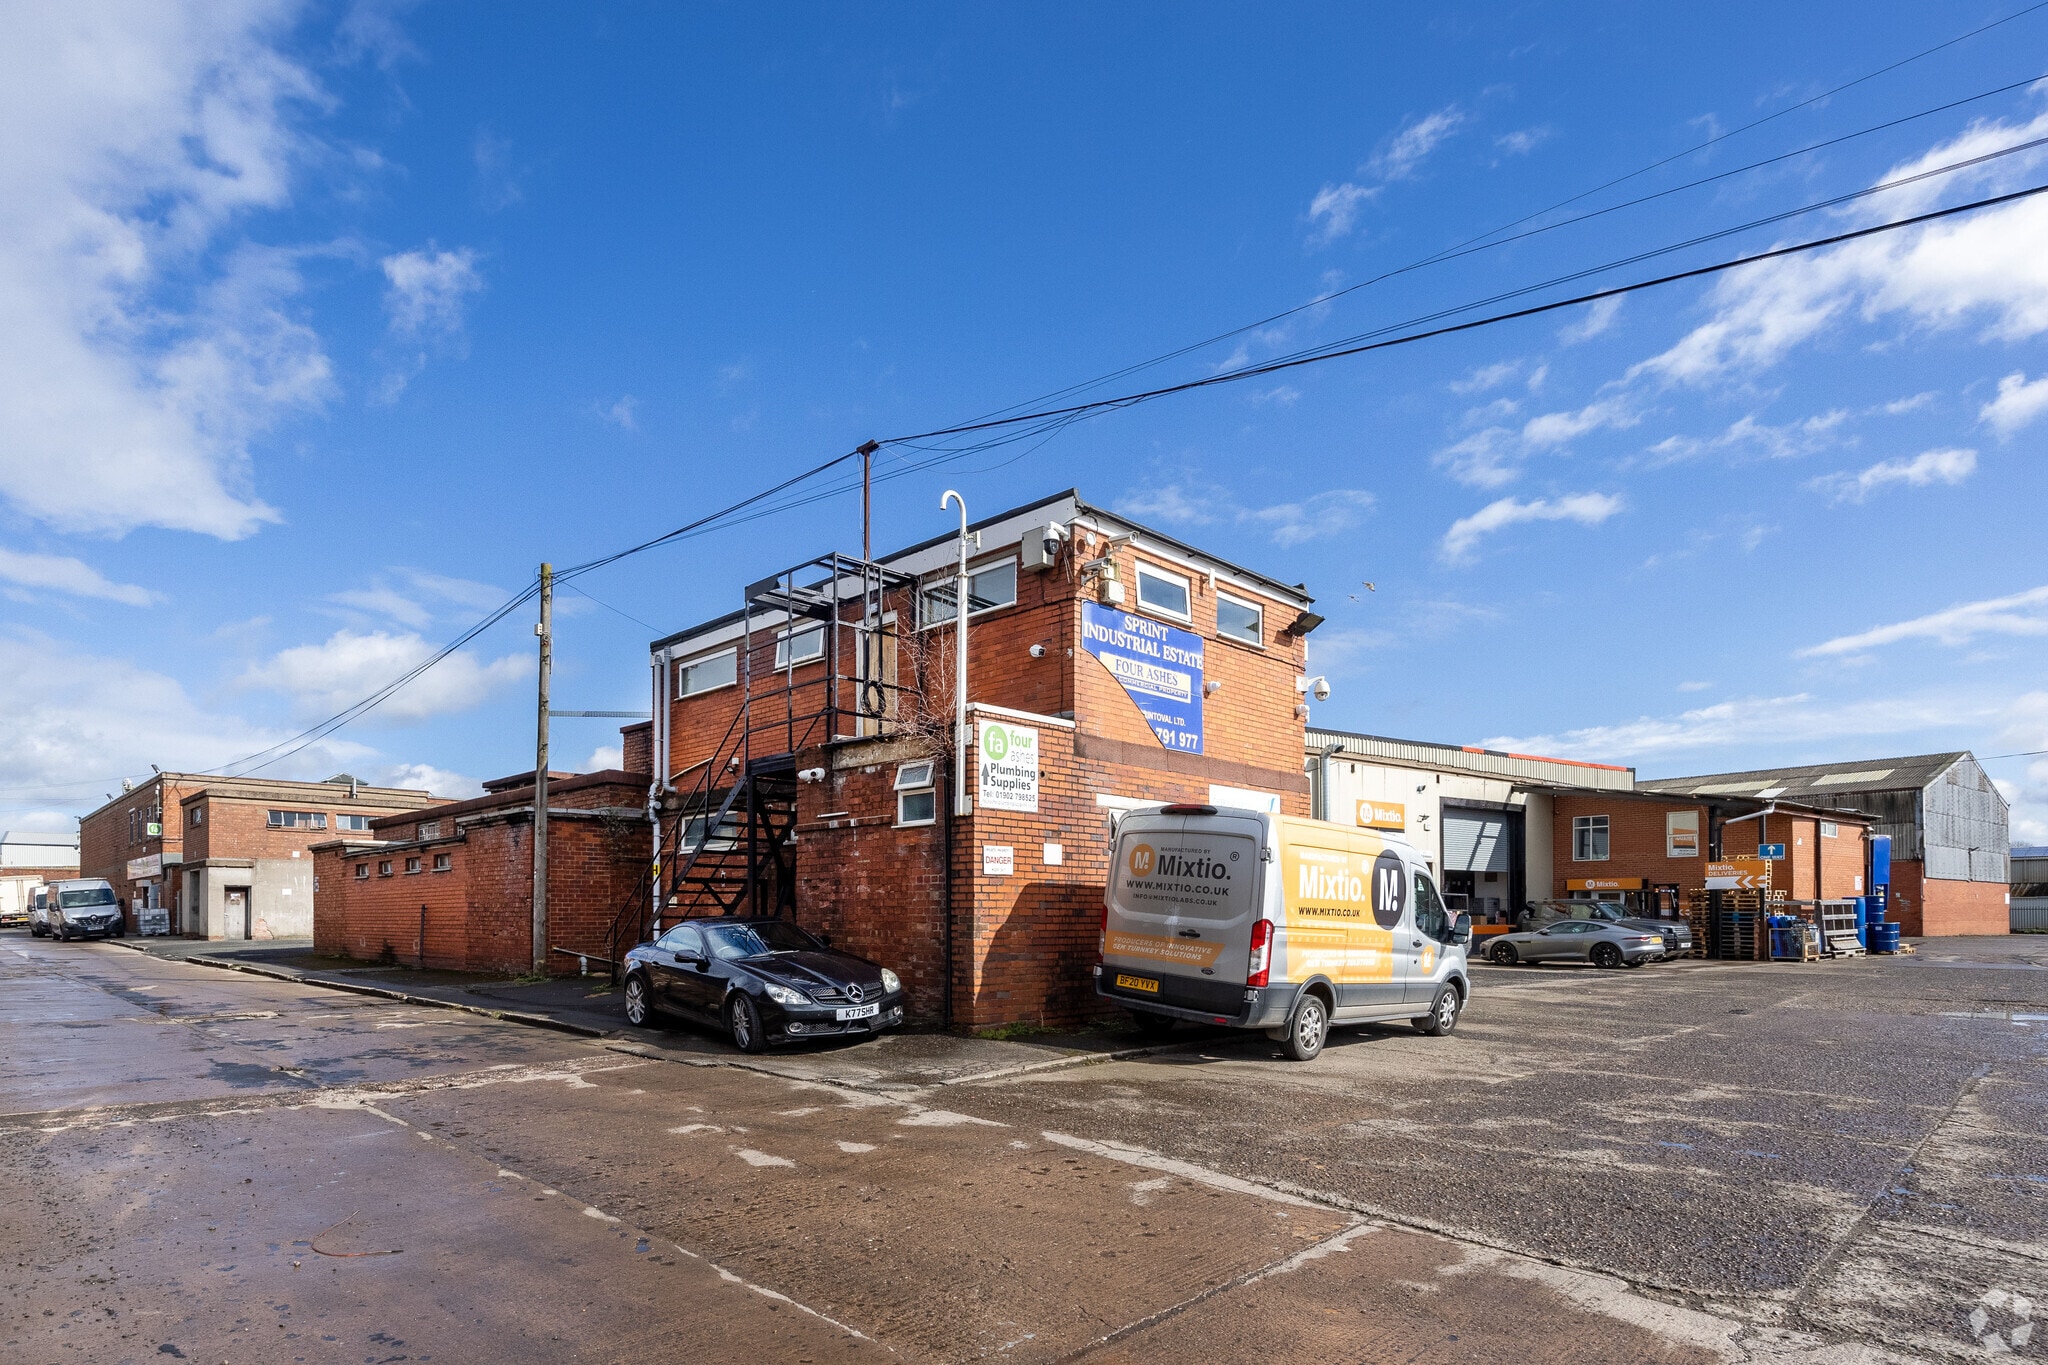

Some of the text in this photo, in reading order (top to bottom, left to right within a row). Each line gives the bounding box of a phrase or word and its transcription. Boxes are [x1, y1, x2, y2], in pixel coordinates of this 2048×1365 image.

[1124, 615, 1169, 642] SPRINT
[1083, 621, 1204, 670] INDUSTRIAL ESTATE
[1115, 658, 1178, 686] FOUR ASHES
[1158, 684, 1189, 698] PROPERTY
[1173, 716, 1187, 727] LTD.
[988, 731, 1004, 754] fa
[1010, 730, 1033, 749] four
[1155, 727, 1199, 750] 791 977
[990, 763, 1036, 782] Plumbing
[990, 775, 1031, 791] Supplies
[995, 790, 1014, 800] 01902
[1160, 846, 1203, 854] MANUFACTURED
[985, 855, 1012, 865] DANGER
[1157, 854, 1231, 880] Mixtio.
[1708, 869, 1748, 877] DELIVERIES
[1126, 880, 1230, 897] WWW.MIXTIO.CO.UK
[1299, 863, 1366, 902] Mixtio.
[1133, 893, 1218, 906] INFO@MIXTIOLABS.CO.UK
[1298, 906, 1361, 918] WWW.MIXTIO.CO.UK
[1113, 936, 1154, 947] PRODUCERS
[1166, 942, 1213, 954] INNOVATIVE
[1127, 945, 1160, 955] TURNKEY
[1159, 948, 1202, 961] SOLUTIONS
[1119, 975, 1156, 990] BF20 YVX
[845, 1005, 874, 1019] K77SHR
